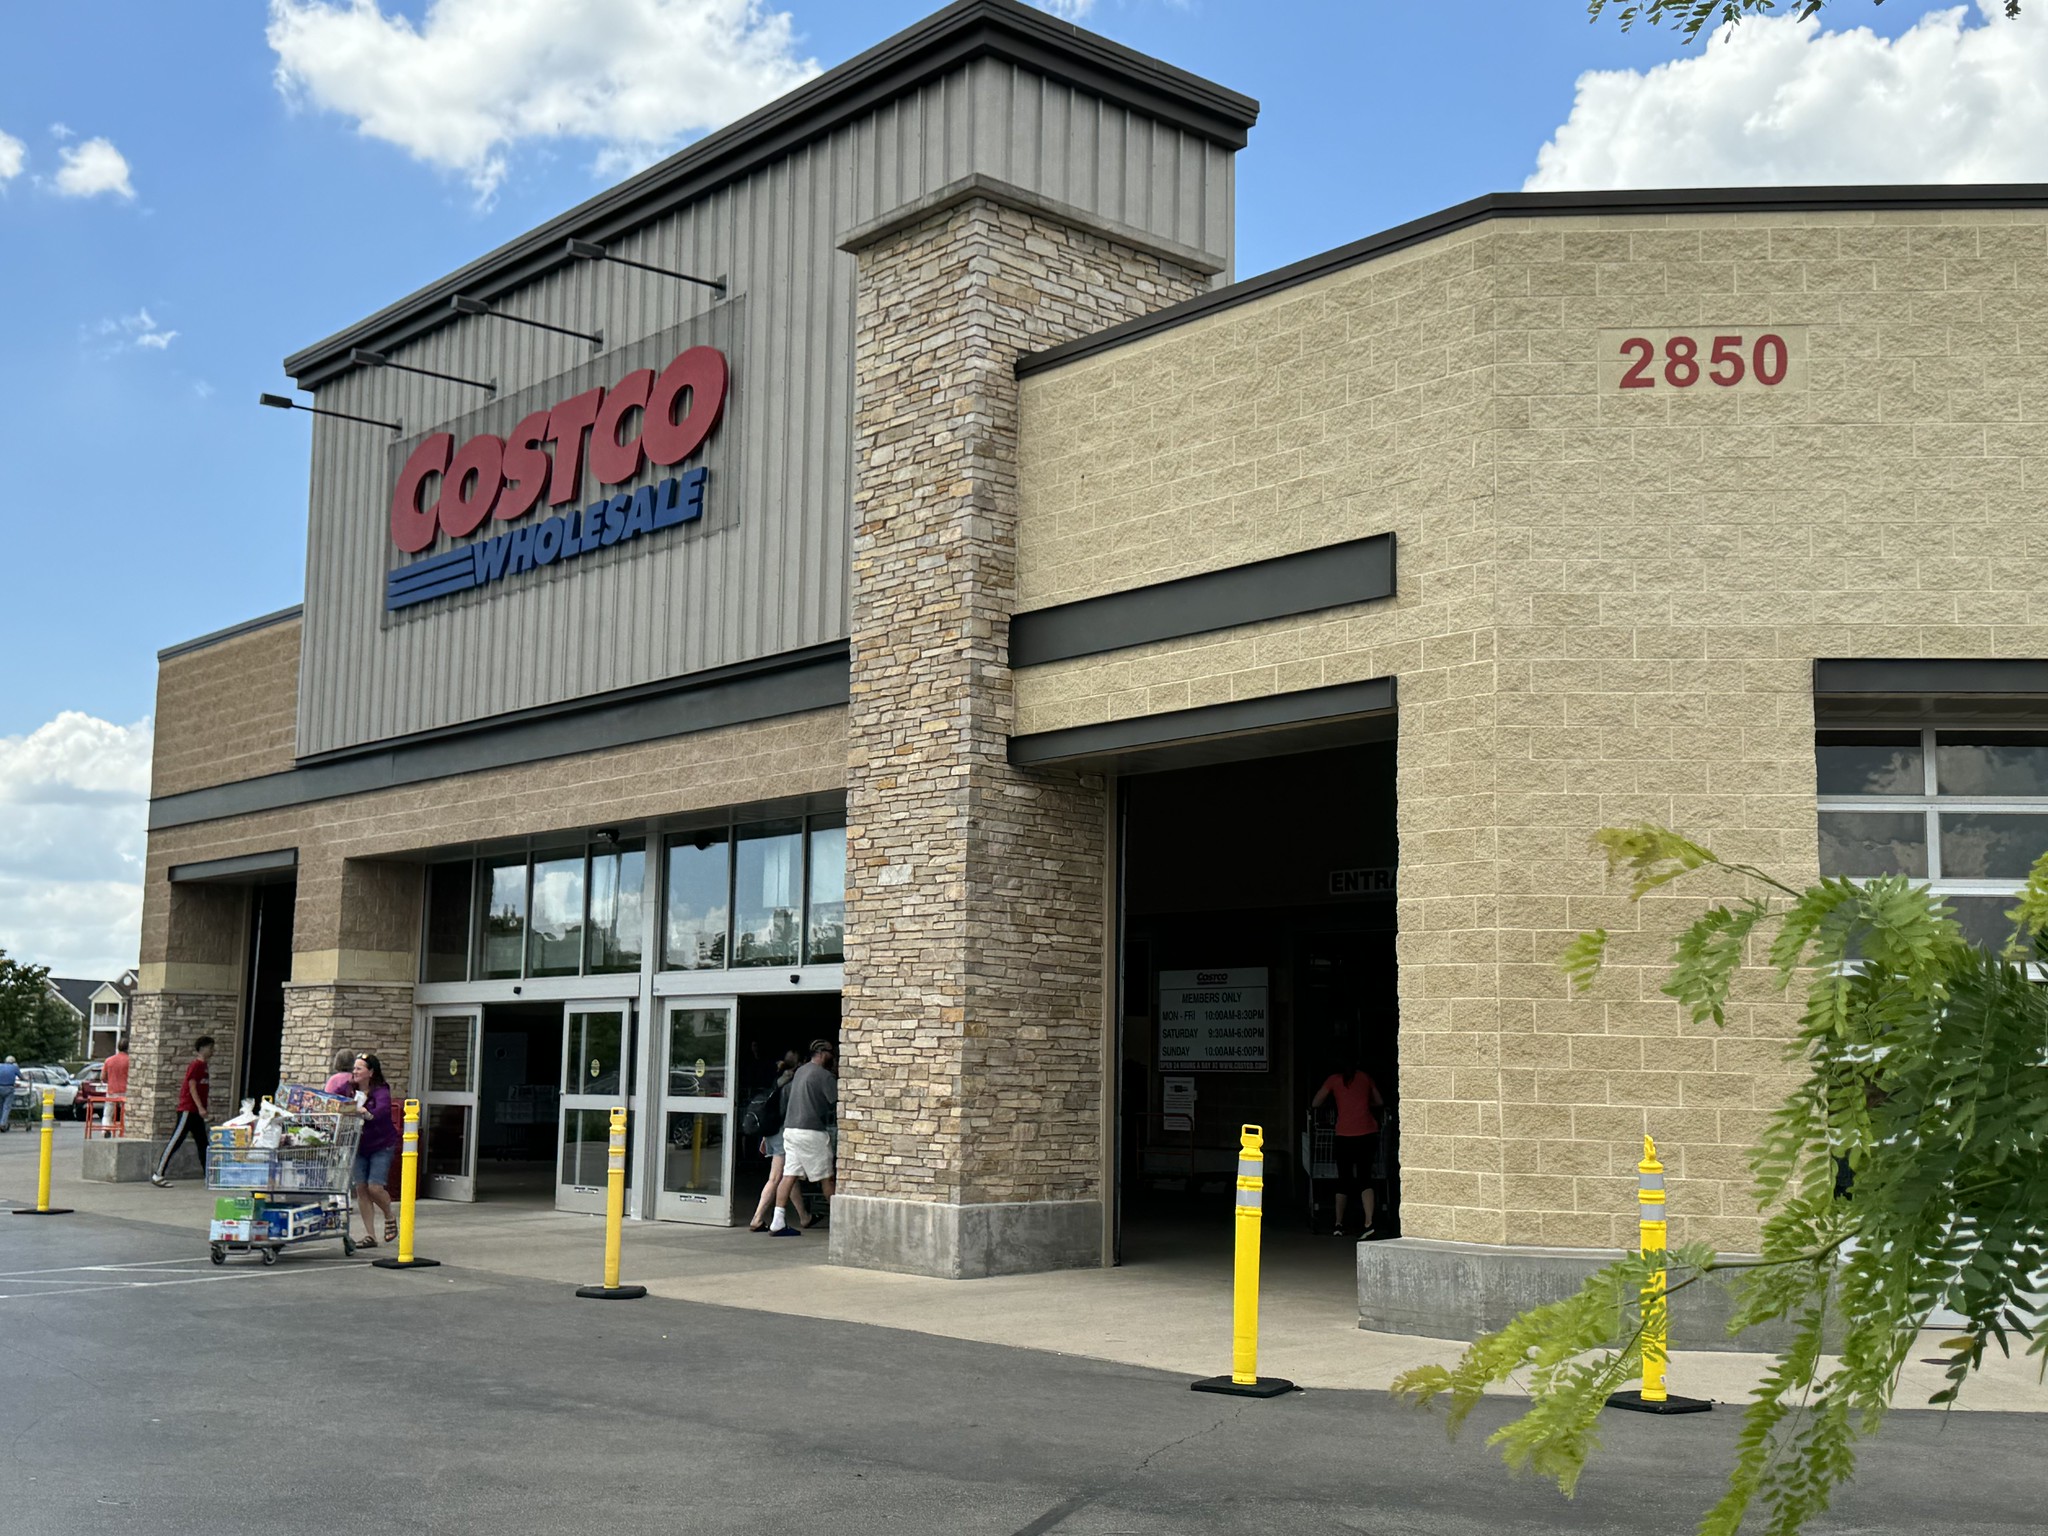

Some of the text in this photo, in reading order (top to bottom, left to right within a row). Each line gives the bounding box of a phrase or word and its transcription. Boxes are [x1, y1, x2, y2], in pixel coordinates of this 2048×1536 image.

[1619, 333, 1788, 389] 2850
[390, 345, 729, 553] COSTCO
[471, 466, 708, 585] WHOLESALE
[1182, 992, 1242, 1003] MEMBERS ONLY
[1162, 1011, 1178, 1021] MON
[1184, 1010, 1196, 1020] FRI
[1162, 1028, 1198, 1039] SATURDAY
[1162, 1046, 1190, 1056] SUNDAY
